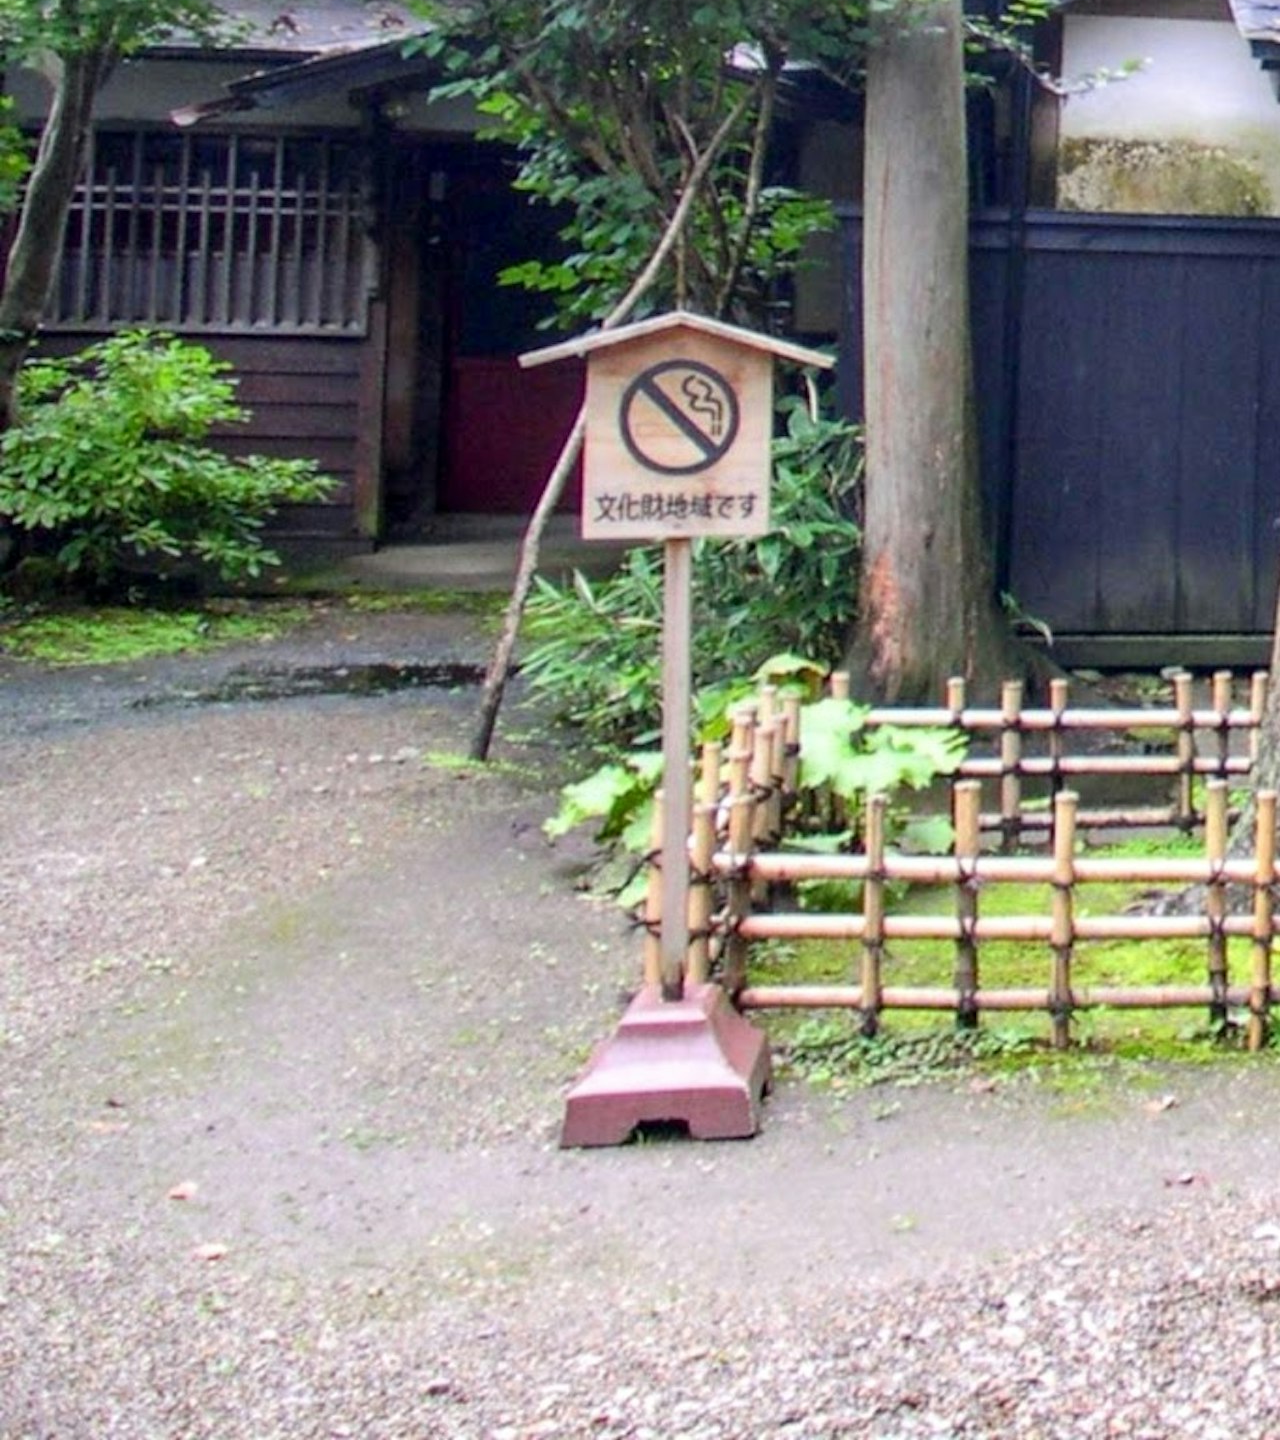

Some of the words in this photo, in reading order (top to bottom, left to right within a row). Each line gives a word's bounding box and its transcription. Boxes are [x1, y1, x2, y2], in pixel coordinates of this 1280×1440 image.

[594, 493, 758, 521] 文化財地域です
